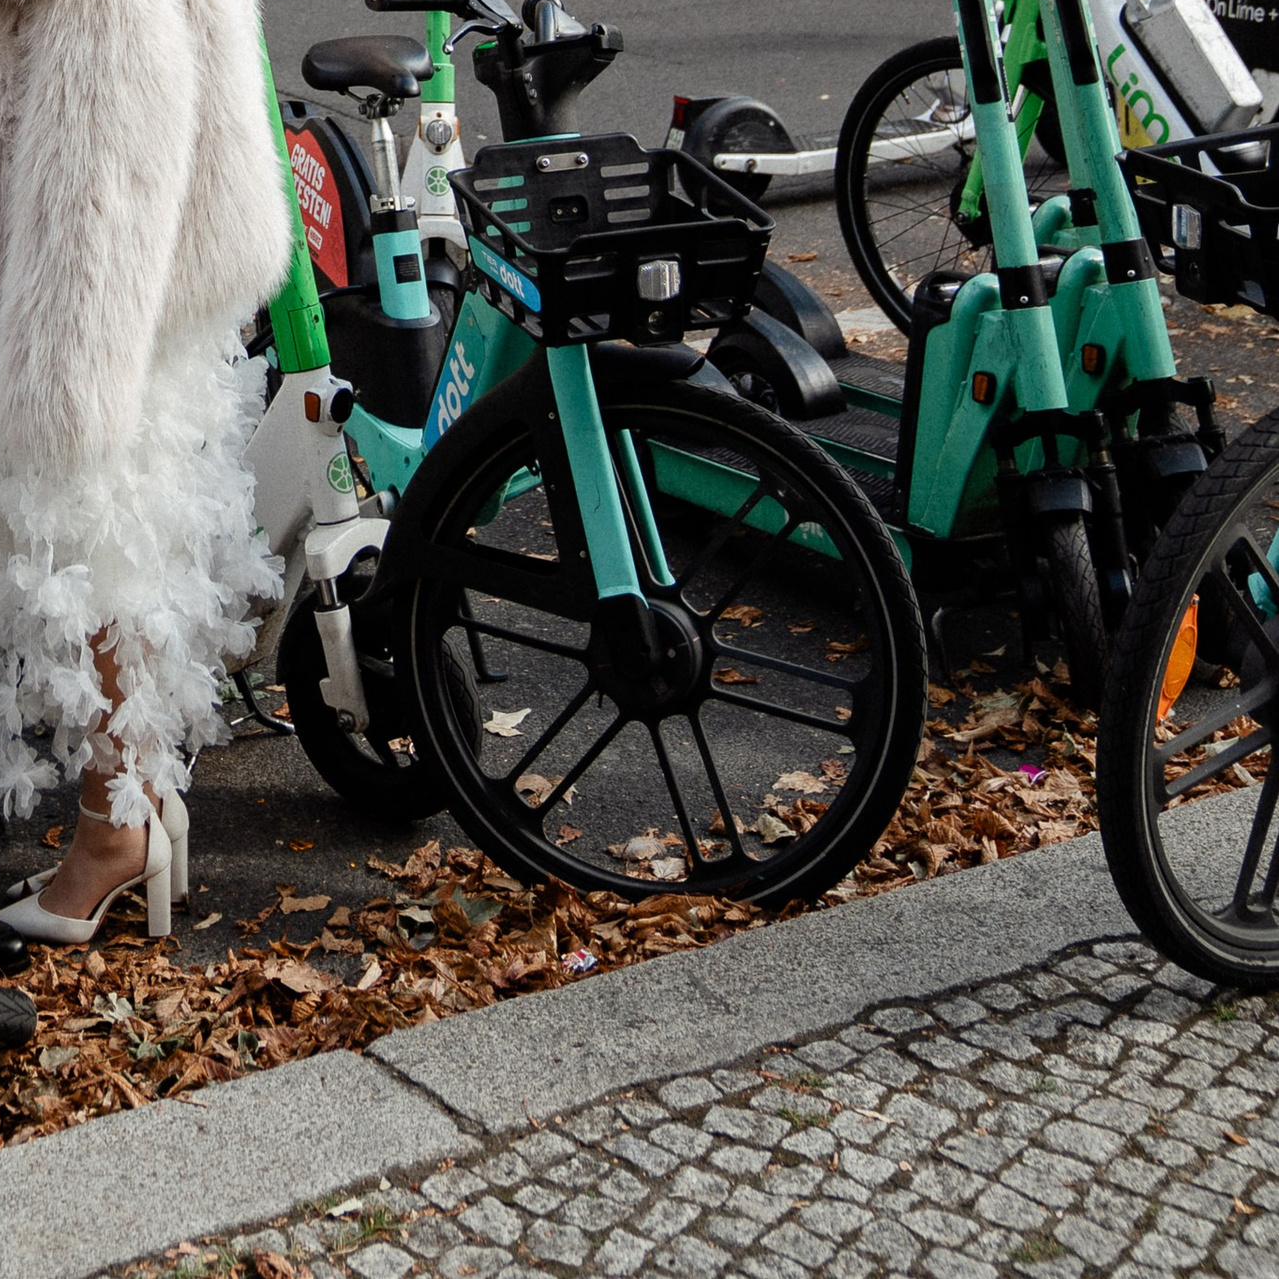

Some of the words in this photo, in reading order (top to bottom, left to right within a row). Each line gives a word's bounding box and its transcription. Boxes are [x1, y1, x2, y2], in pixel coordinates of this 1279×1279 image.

[291, 143, 326, 191] GRATIS
[499, 264, 526, 299] dott
[437, 340, 475, 437] dott
